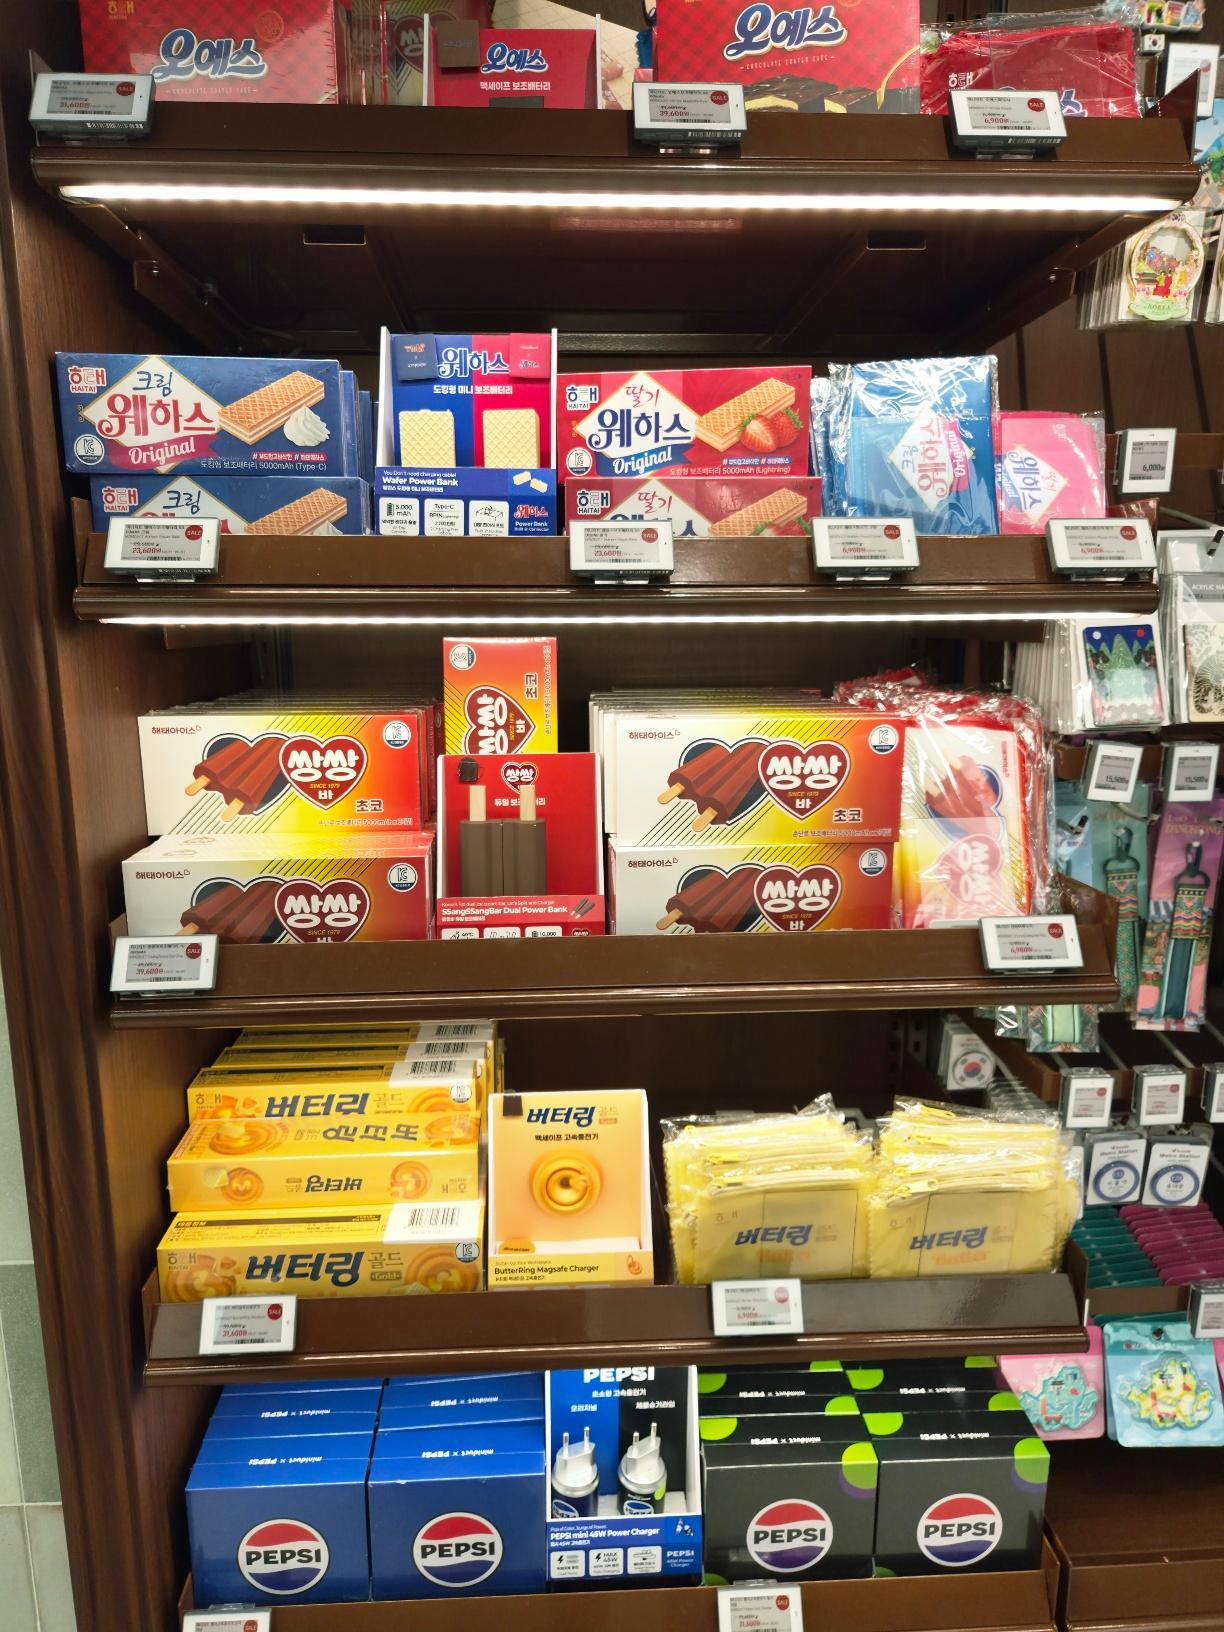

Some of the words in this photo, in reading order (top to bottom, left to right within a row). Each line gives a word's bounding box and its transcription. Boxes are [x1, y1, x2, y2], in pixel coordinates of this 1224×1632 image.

[723, 3, 848, 61] 오예스
[151, 28, 269, 82] 오예스
[480, 41, 549, 73] 오예스
[512, 81, 550, 91] 보조배터리
[436, 347, 510, 378] 웨하스
[132, 371, 173, 396] 크림
[625, 384, 659, 408] 딸기
[97, 393, 217, 438] 웨하스
[587, 408, 692, 450] 웨하스
[128, 437, 196, 465] Original
[901, 443, 919, 474] 크림
[917, 417, 947, 499] 웨하스
[946, 428, 967, 479] Original
[259, 462, 293, 470] 5000mAh
[295, 462, 327, 471] (Type-C)
[612, 446, 673, 475] Original
[722, 467, 755, 475] 5000mAh
[756, 466, 791, 475] (Lightning)
[382, 476, 408, 485] Wafer
[409, 477, 435, 485] Power
[437, 478, 459, 486] Bank
[1007, 451, 1042, 511] 웨하스
[105, 504, 128, 512] HAITAI
[163, 490, 201, 514] 크림
[638, 489, 673, 513] 딸기
[525, 673, 538, 699] 초코
[151, 726, 196, 735] 해태아이스
[515, 719, 526, 734] 바
[628, 731, 675, 740] 해태아이스
[287, 749, 360, 783] 쌍쌍
[766, 755, 842, 790] 쌍쌍
[505, 768, 534, 783] 쌍쌍
[317, 790, 334, 800] 바
[795, 798, 812, 809] 바
[355, 799, 384, 813] 초코
[832, 809, 862, 822] 초코
[628, 859, 673, 868] 해태아이스
[958, 841, 991, 900] 쌍쌍
[135, 871, 184, 880] 해태아이스
[761, 878, 834, 913] 쌍쌍
[284, 893, 362, 928] 쌍쌍
[441, 907, 502, 917] SSangSSangBar
[521, 906, 547, 914] Power
[548, 905, 568, 913] Bank
[789, 920, 805, 930] 바
[527, 1106, 596, 1128] 버터링
[304, 1174, 363, 1192] 버터링
[734, 1224, 813, 1246] 버터링
[909, 1226, 988, 1251] 버터링
[245, 1250, 365, 1288] 버터링
[367, 1252, 404, 1269] 골드
[374, 1272, 397, 1281] Gold
[494, 1267, 536, 1275] ButterRing
[537, 1265, 568, 1274] Magsafe
[569, 1265, 599, 1273] Charger
[583, 1366, 656, 1384] PEPSI
[430, 1399, 457, 1407] PEPSI
[261, 1410, 288, 1418] PEPSI
[750, 1437, 779, 1446] PEPSI
[920, 1433, 948, 1441] PEPSI
[248, 1457, 277, 1466] PEPSI
[422, 1450, 450, 1459] PEPSI
[550, 1532, 571, 1541] PEPSI
[572, 1531, 588, 1539] mini
[589, 1530, 606, 1538] 45W
[607, 1529, 630, 1537] Power
[631, 1527, 660, 1536] Charger
[753, 1527, 827, 1545] PEPSI
[924, 1521, 996, 1539] PEPSI
[245, 1548, 322, 1567] PEPSI
[420, 1541, 496, 1559] PEPSI
